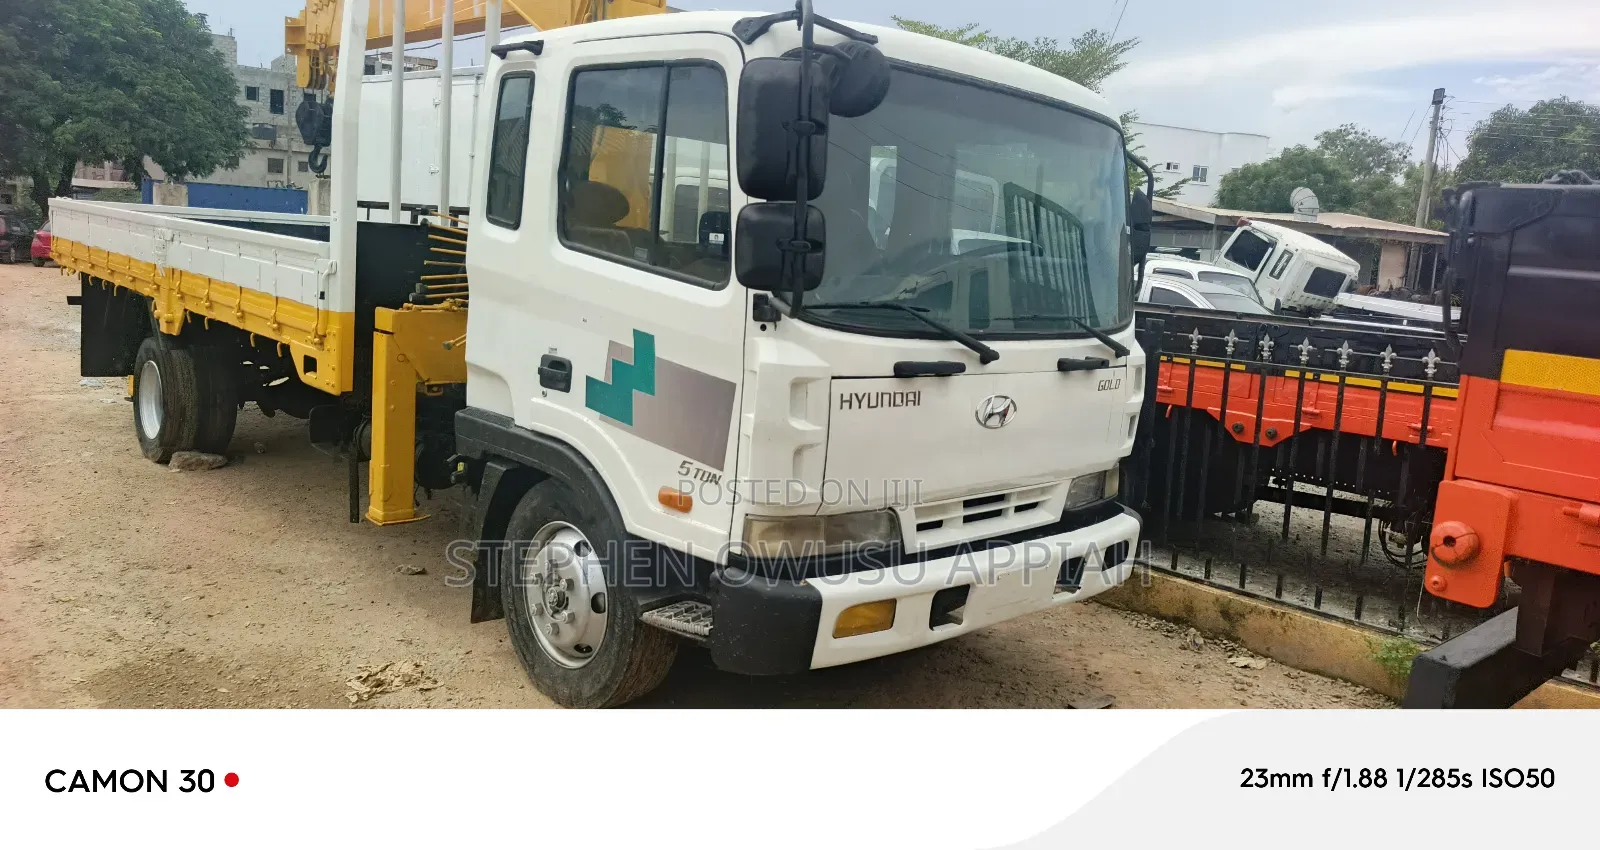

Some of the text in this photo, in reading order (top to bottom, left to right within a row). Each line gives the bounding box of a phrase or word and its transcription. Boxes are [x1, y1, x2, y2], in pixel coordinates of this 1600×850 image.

[1097, 378, 1121, 392] GOLD
[839, 390, 922, 410] HYUNDAI
[677, 460, 723, 486] 5 TON
